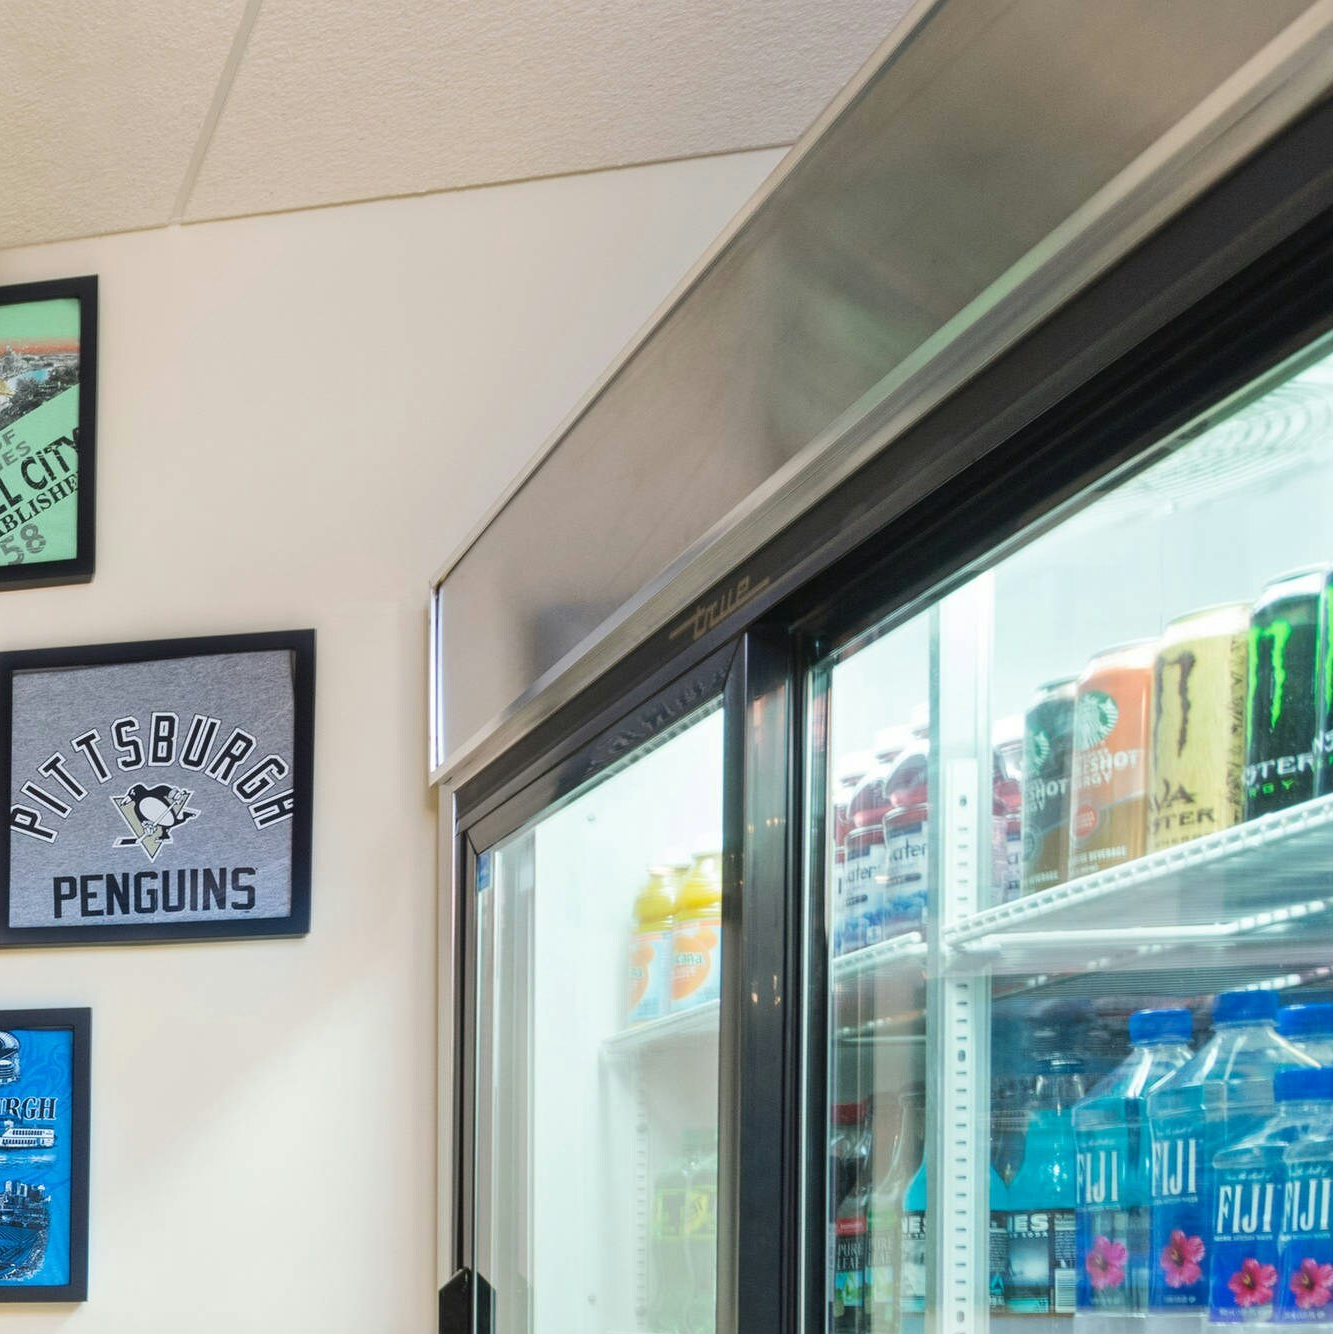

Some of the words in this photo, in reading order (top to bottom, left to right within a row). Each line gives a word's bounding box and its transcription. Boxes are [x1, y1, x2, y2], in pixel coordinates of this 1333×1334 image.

[10, 711, 295, 844] PITTSBURGH
[52, 867, 258, 918] PENGUINS
[1216, 1182, 1275, 1235] FIJI
